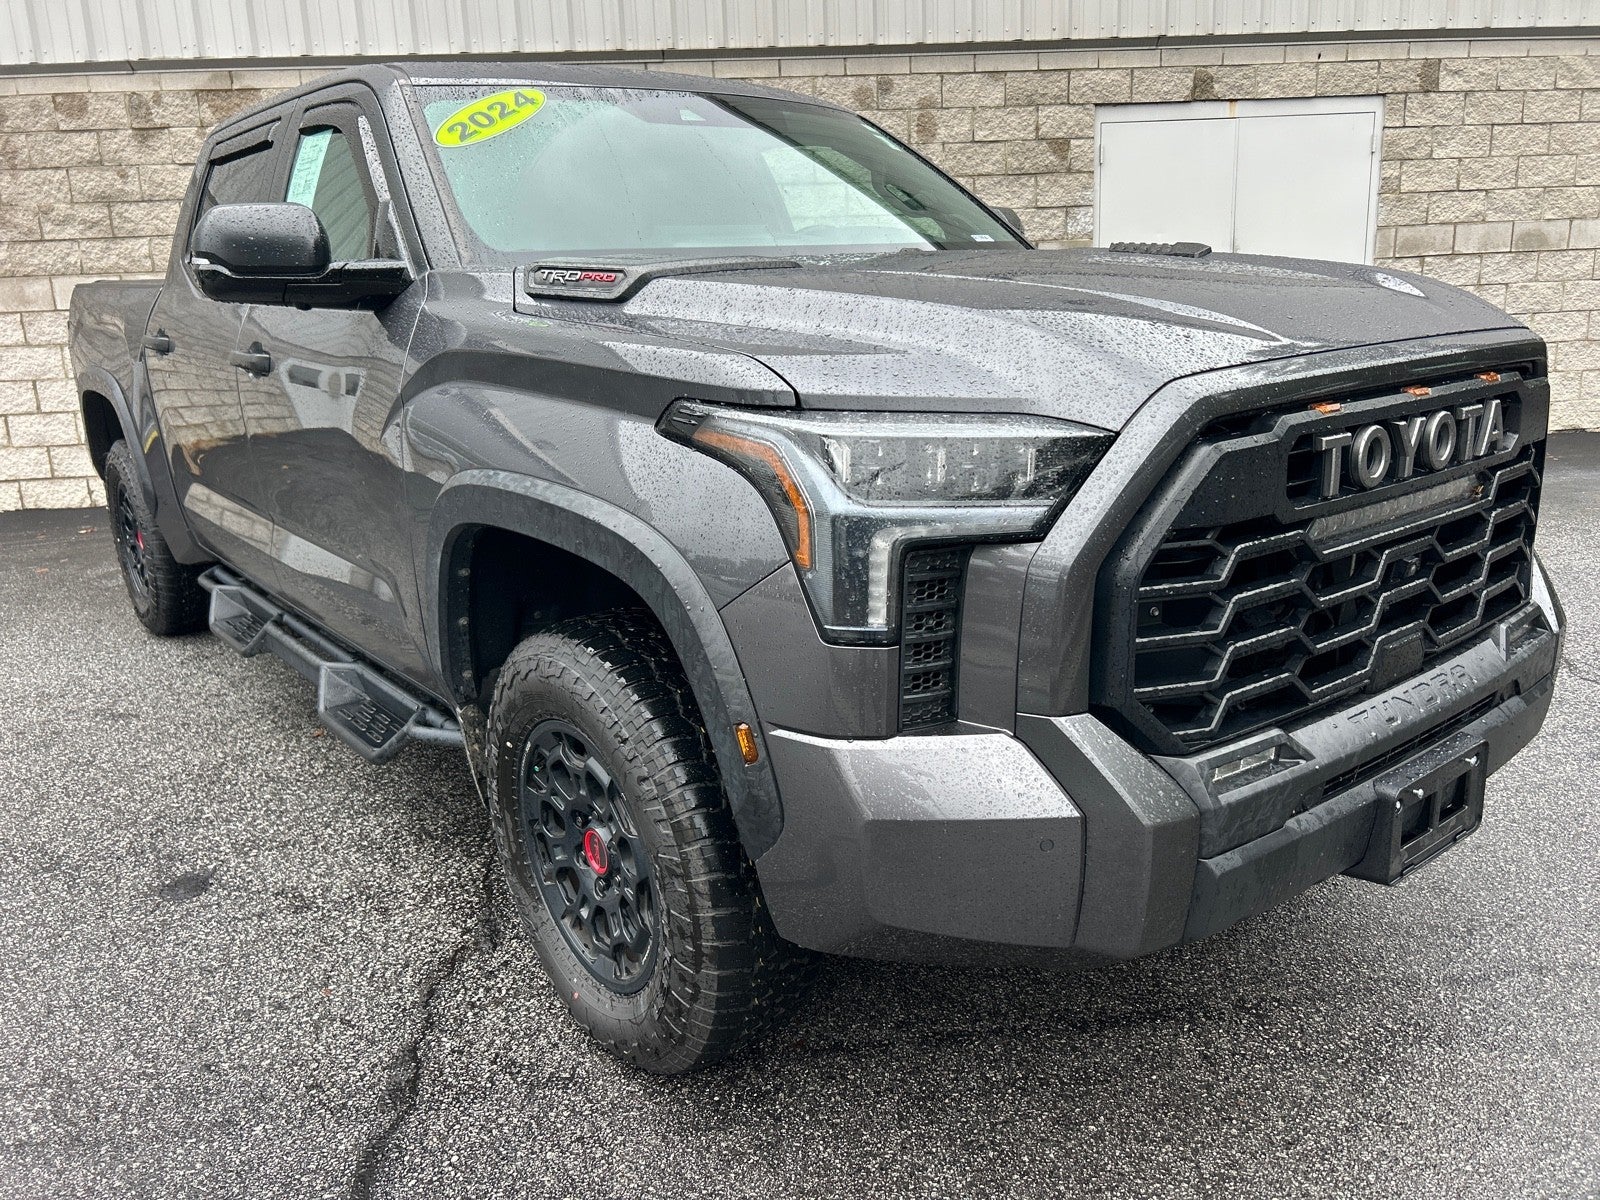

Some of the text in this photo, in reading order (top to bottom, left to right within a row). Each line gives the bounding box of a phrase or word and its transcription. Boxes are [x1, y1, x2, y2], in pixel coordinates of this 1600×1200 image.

[446, 91, 537, 142] 2024
[1314, 399, 1504, 499] TOYOTA
[1347, 664, 1478, 737] TUNDRA
